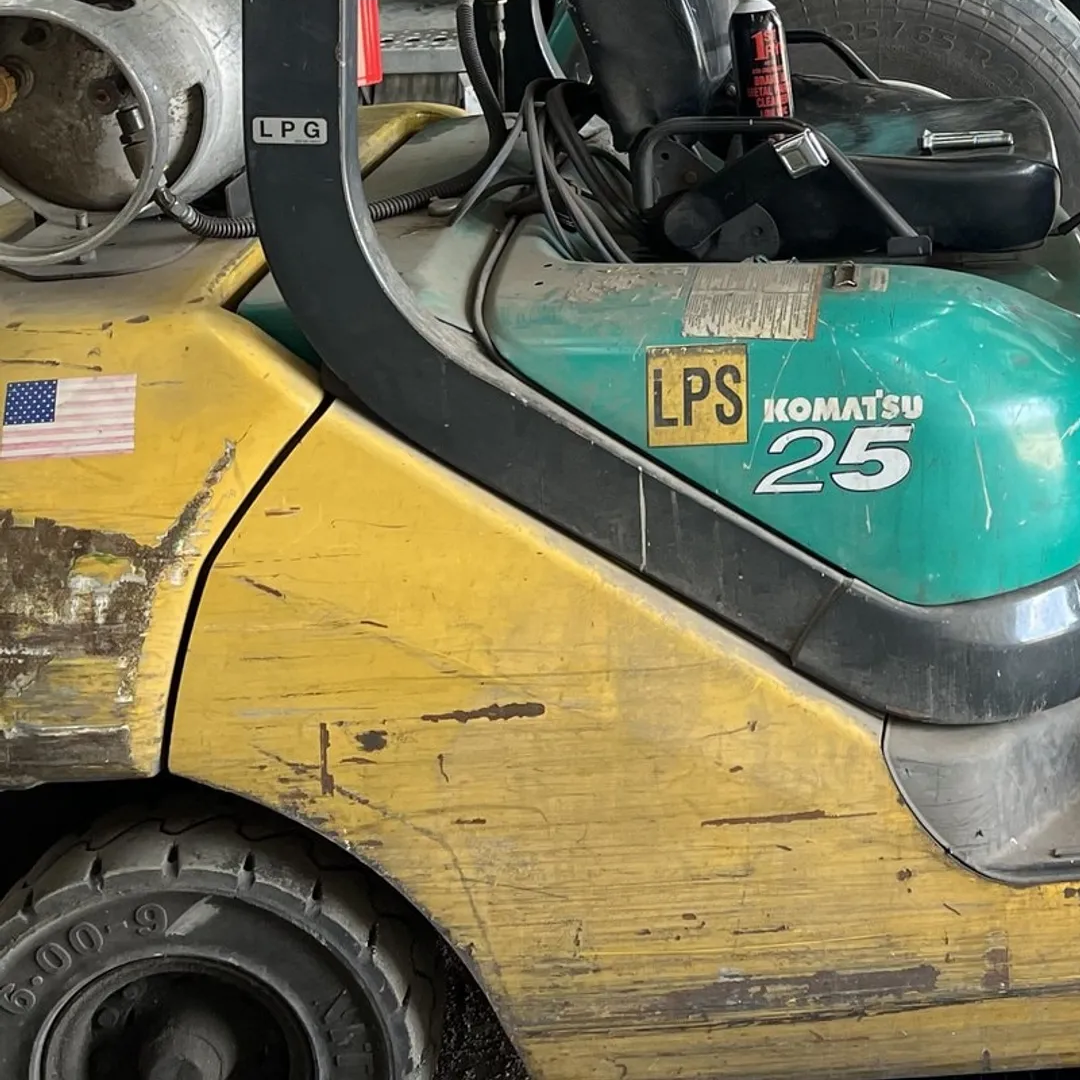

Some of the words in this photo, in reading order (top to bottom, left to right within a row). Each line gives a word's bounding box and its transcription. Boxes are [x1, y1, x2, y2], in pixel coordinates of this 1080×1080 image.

[653, 364, 743, 428] LPS
[764, 389, 923, 422] KOMATSU
[753, 423, 916, 495] 25
